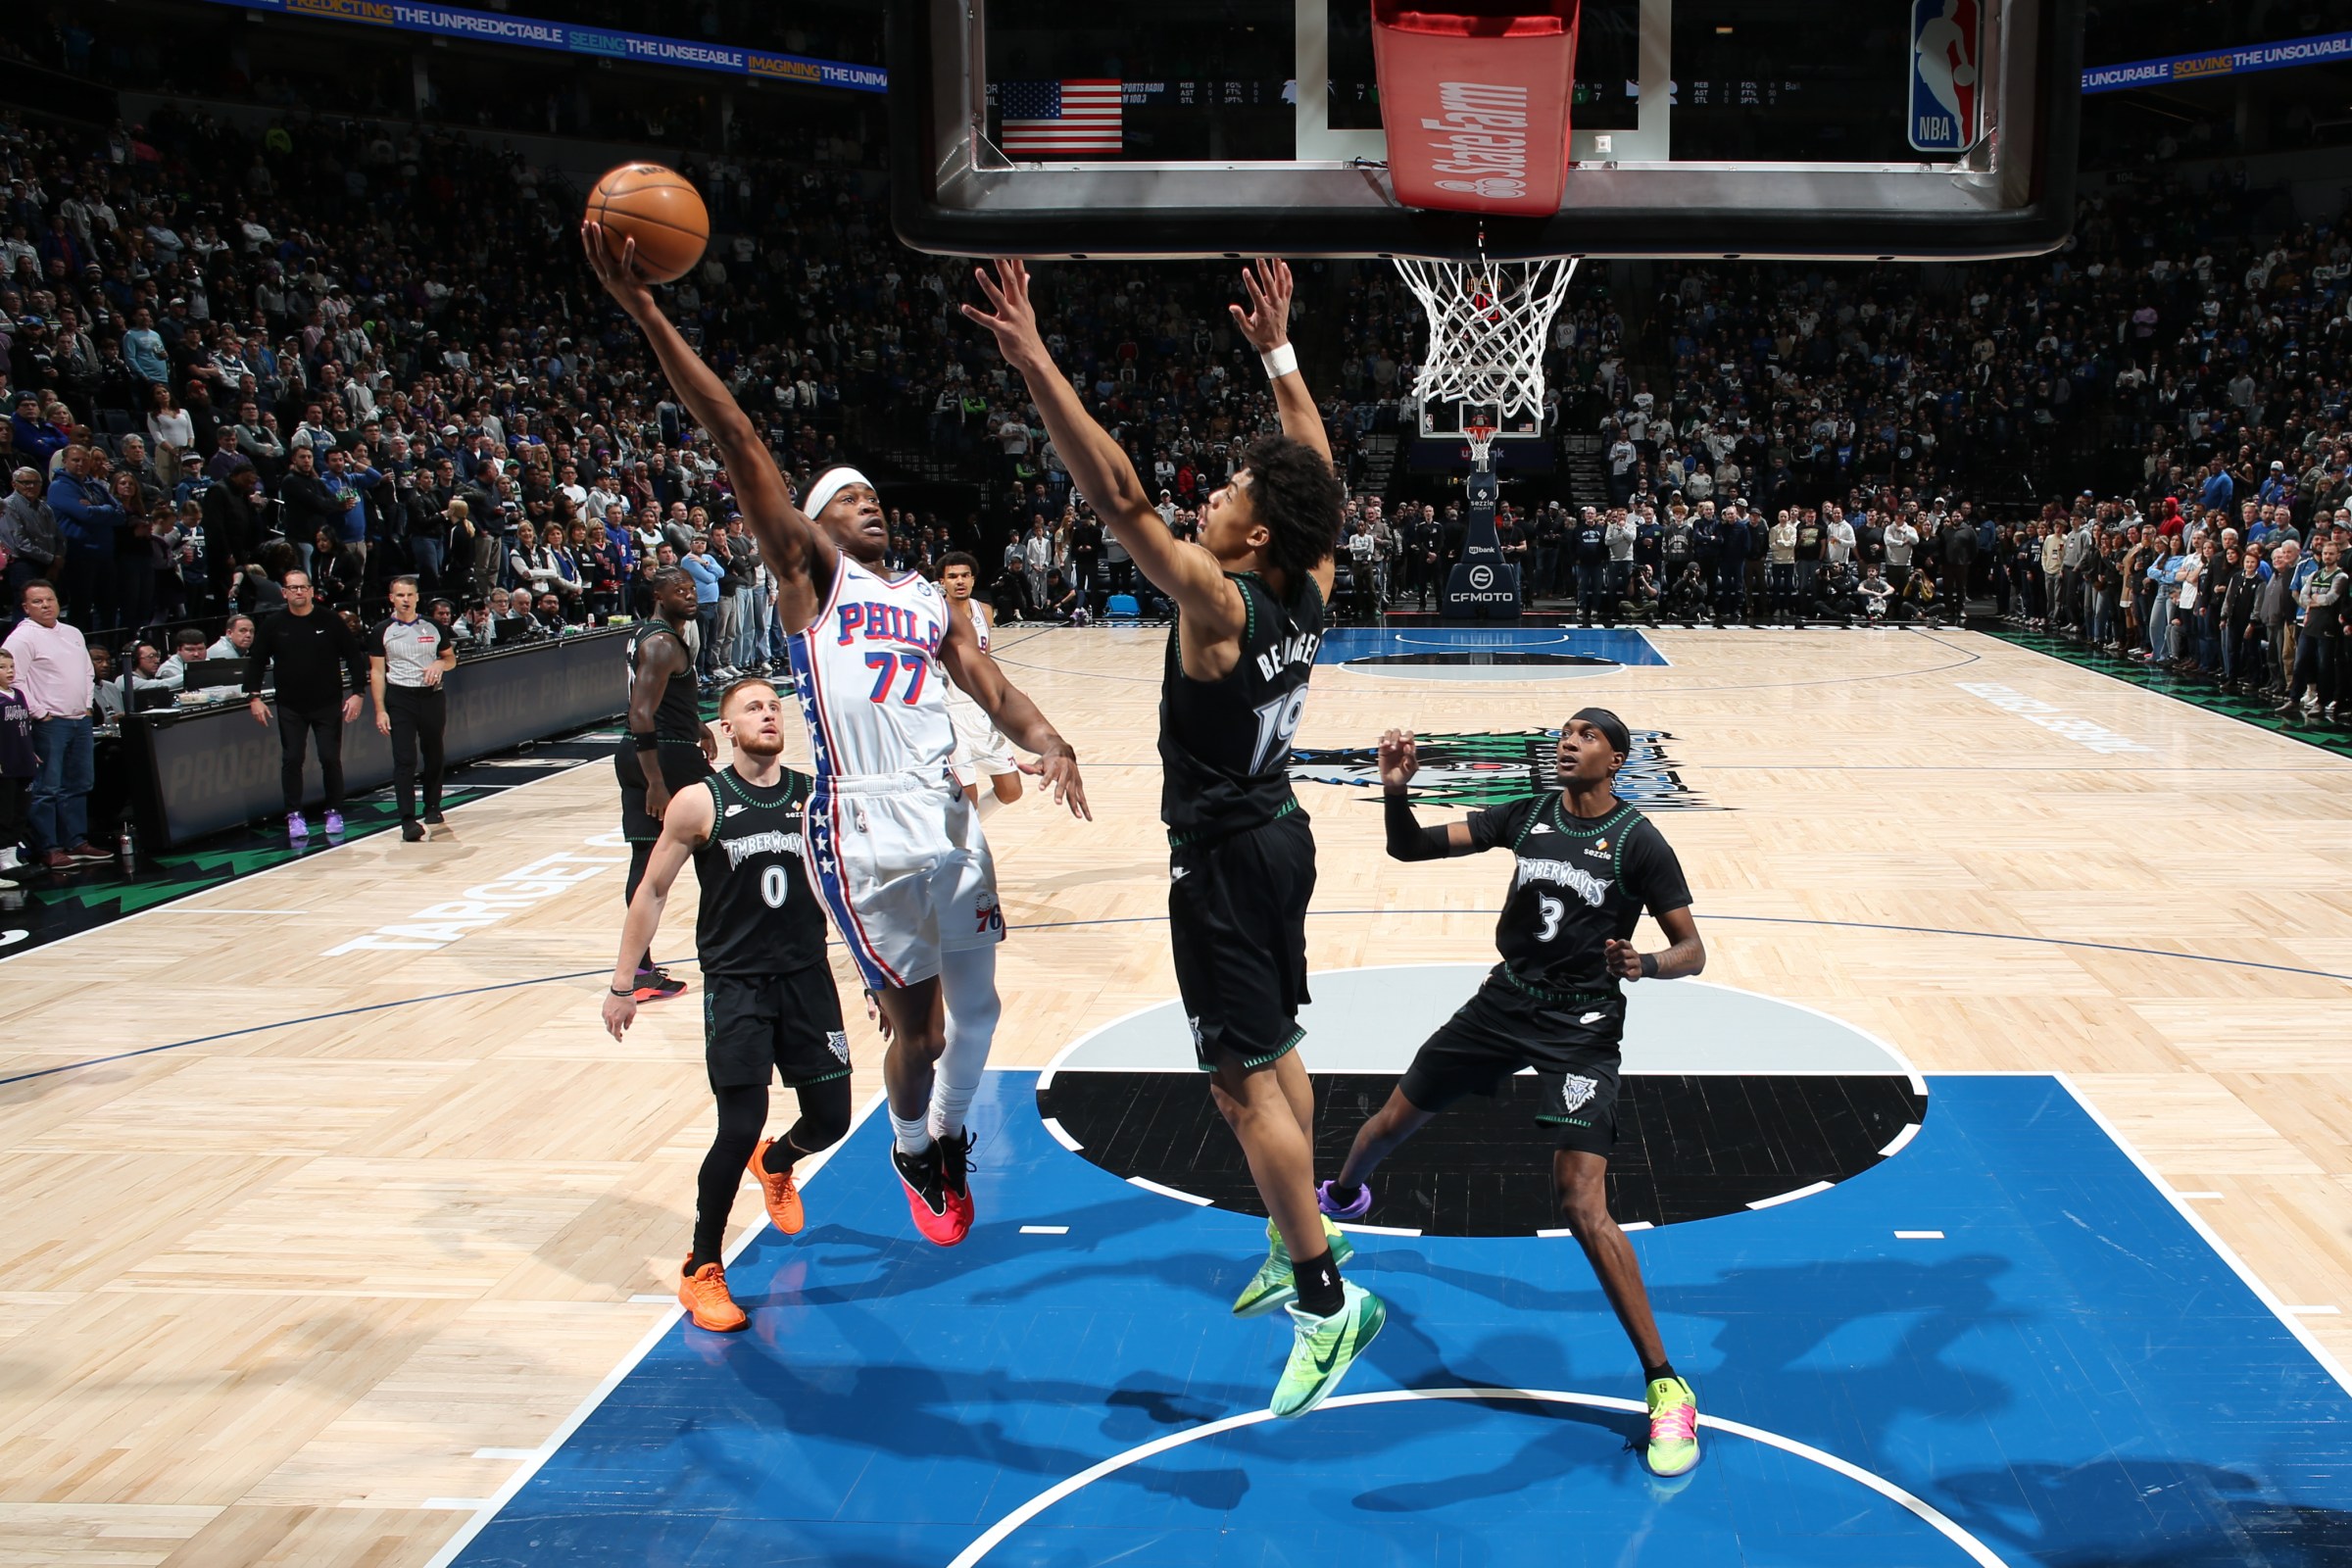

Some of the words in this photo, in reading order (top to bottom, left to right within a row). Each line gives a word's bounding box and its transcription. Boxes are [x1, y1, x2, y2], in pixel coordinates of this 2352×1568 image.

[394, 6, 430, 25] THE
[431, 12, 564, 43] UNPREDICTABLE
[568, 30, 626, 51] SEEING
[626, 38, 658, 56] THE
[659, 43, 743, 68] UNSEEABLE
[2173, 55, 2232, 74] SOLVING
[2232, 50, 2263, 67] THE
[749, 55, 821, 76] IMAGINING
[821, 66, 849, 82] THE
[2088, 64, 2169, 86] UNCURABLE
[1130, 93, 1148, 103] 100.3
[1145, 82, 1164, 93] RADIO
[1595, 92, 1601, 101] 7
[1421, 81, 1529, 137] Farm
[1919, 116, 1950, 141] NBA
[1428, 134, 1527, 178] State
[1450, 592, 1513, 603] CFMOTO
[864, 652, 928, 706] 77
[1249, 682, 1310, 776] 19
[718, 829, 805, 872] TIMBERWOLV
[1584, 847, 1612, 860] sezzle
[760, 864, 788, 908] 0
[1515, 854, 1615, 908] TIMBERWOLVES
[318, 852, 629, 956] TARGET
[976, 904, 1003, 933] 76
[1532, 891, 1565, 943] 3
